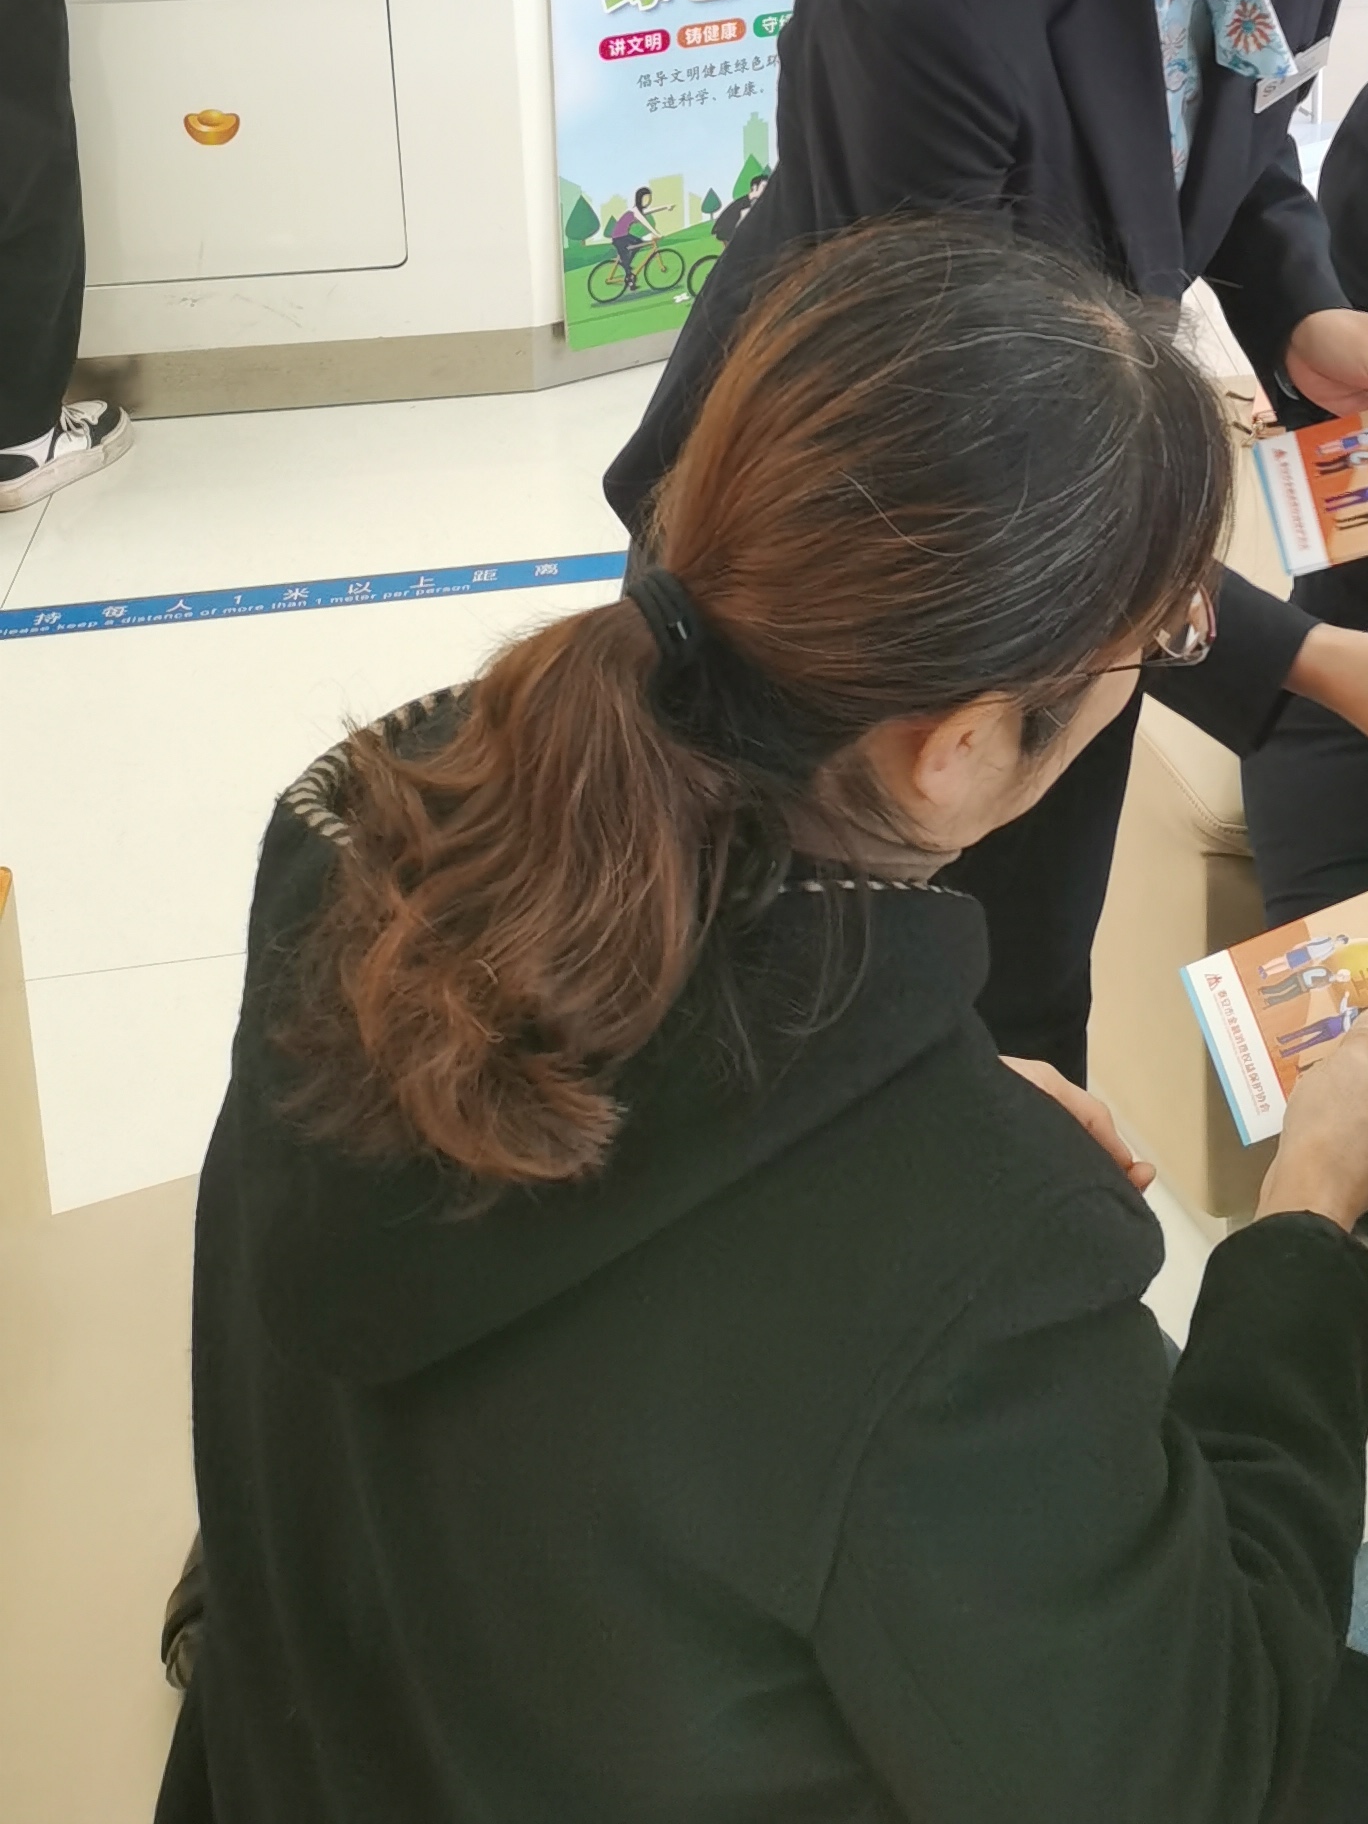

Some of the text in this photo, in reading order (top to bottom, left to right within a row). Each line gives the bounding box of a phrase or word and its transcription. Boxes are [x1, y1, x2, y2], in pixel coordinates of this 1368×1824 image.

[608, 33, 662, 56] 讲文明
[685, 21, 738, 45] 铸健康
[0, 626, 49, 636] lease
[57, 621, 98, 631] keep
[122, 611, 193, 624] distance
[200, 608, 216, 616] of
[223, 604, 264, 614] more
[272, 600, 307, 610] than
[331, 593, 376, 604] meter
[383, 589, 409, 600] per
[415, 584, 470, 596] person
